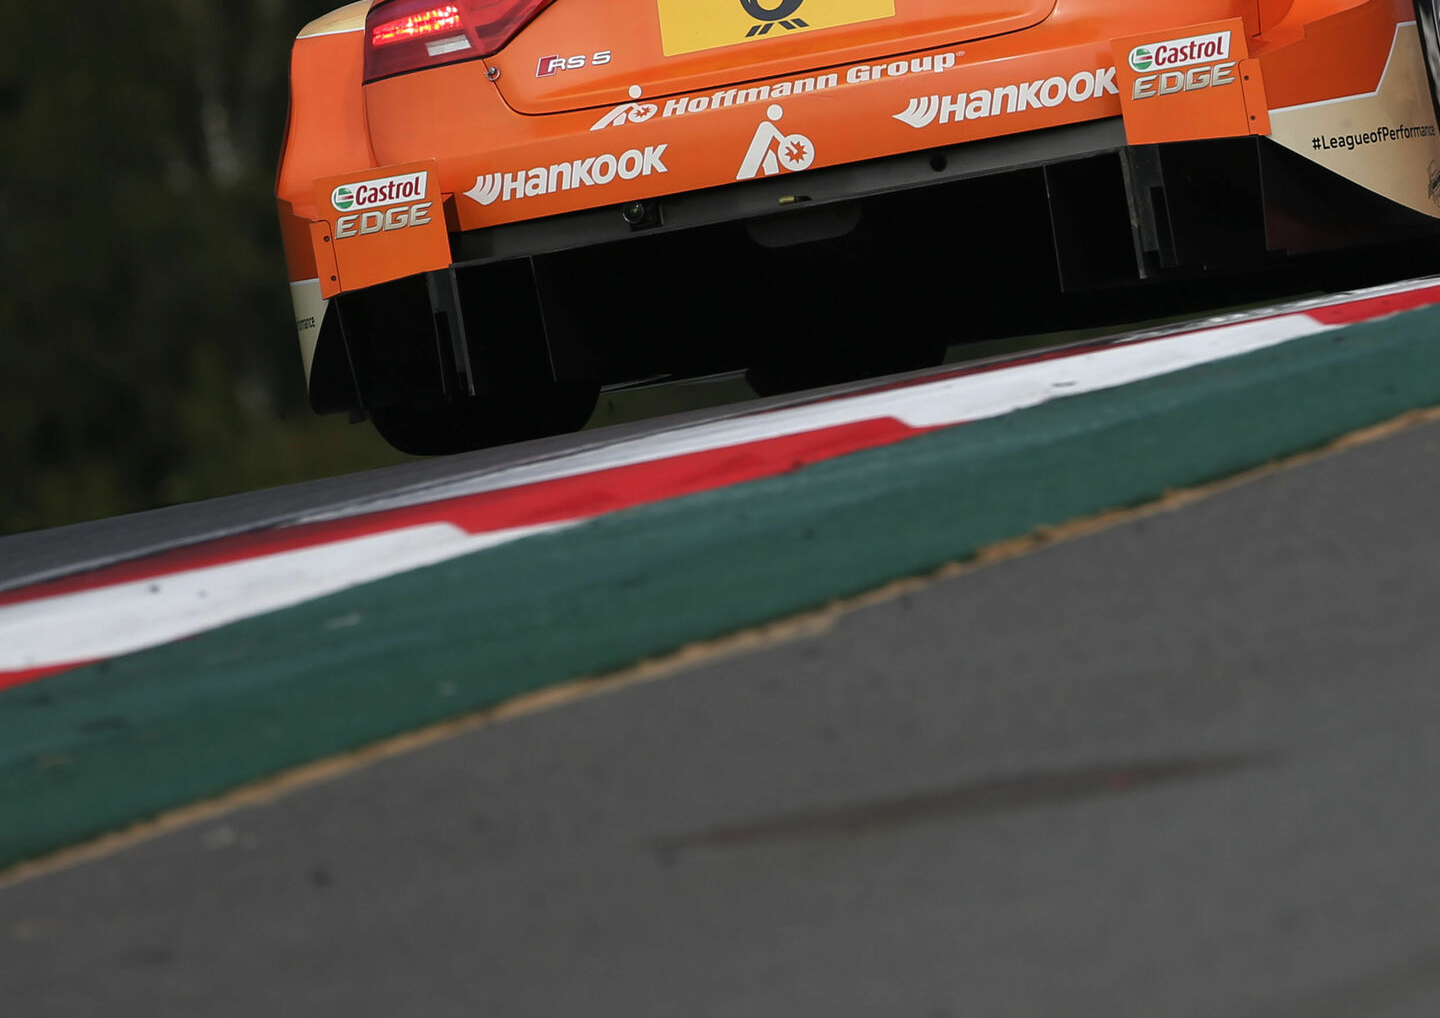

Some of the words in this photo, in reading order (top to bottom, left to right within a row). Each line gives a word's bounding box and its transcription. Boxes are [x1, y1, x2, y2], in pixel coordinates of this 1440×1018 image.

[547, 54, 587, 74] RS
[591, 50, 612, 66] 5
[1154, 36, 1224, 66] Castrol
[662, 73, 838, 118] Hoffmann
[1132, 61, 1238, 100] EDGE
[1312, 124, 1436, 151] #LeagueofPerformance
[355, 176, 421, 206] Castrol
[335, 201, 433, 239] EDGE
